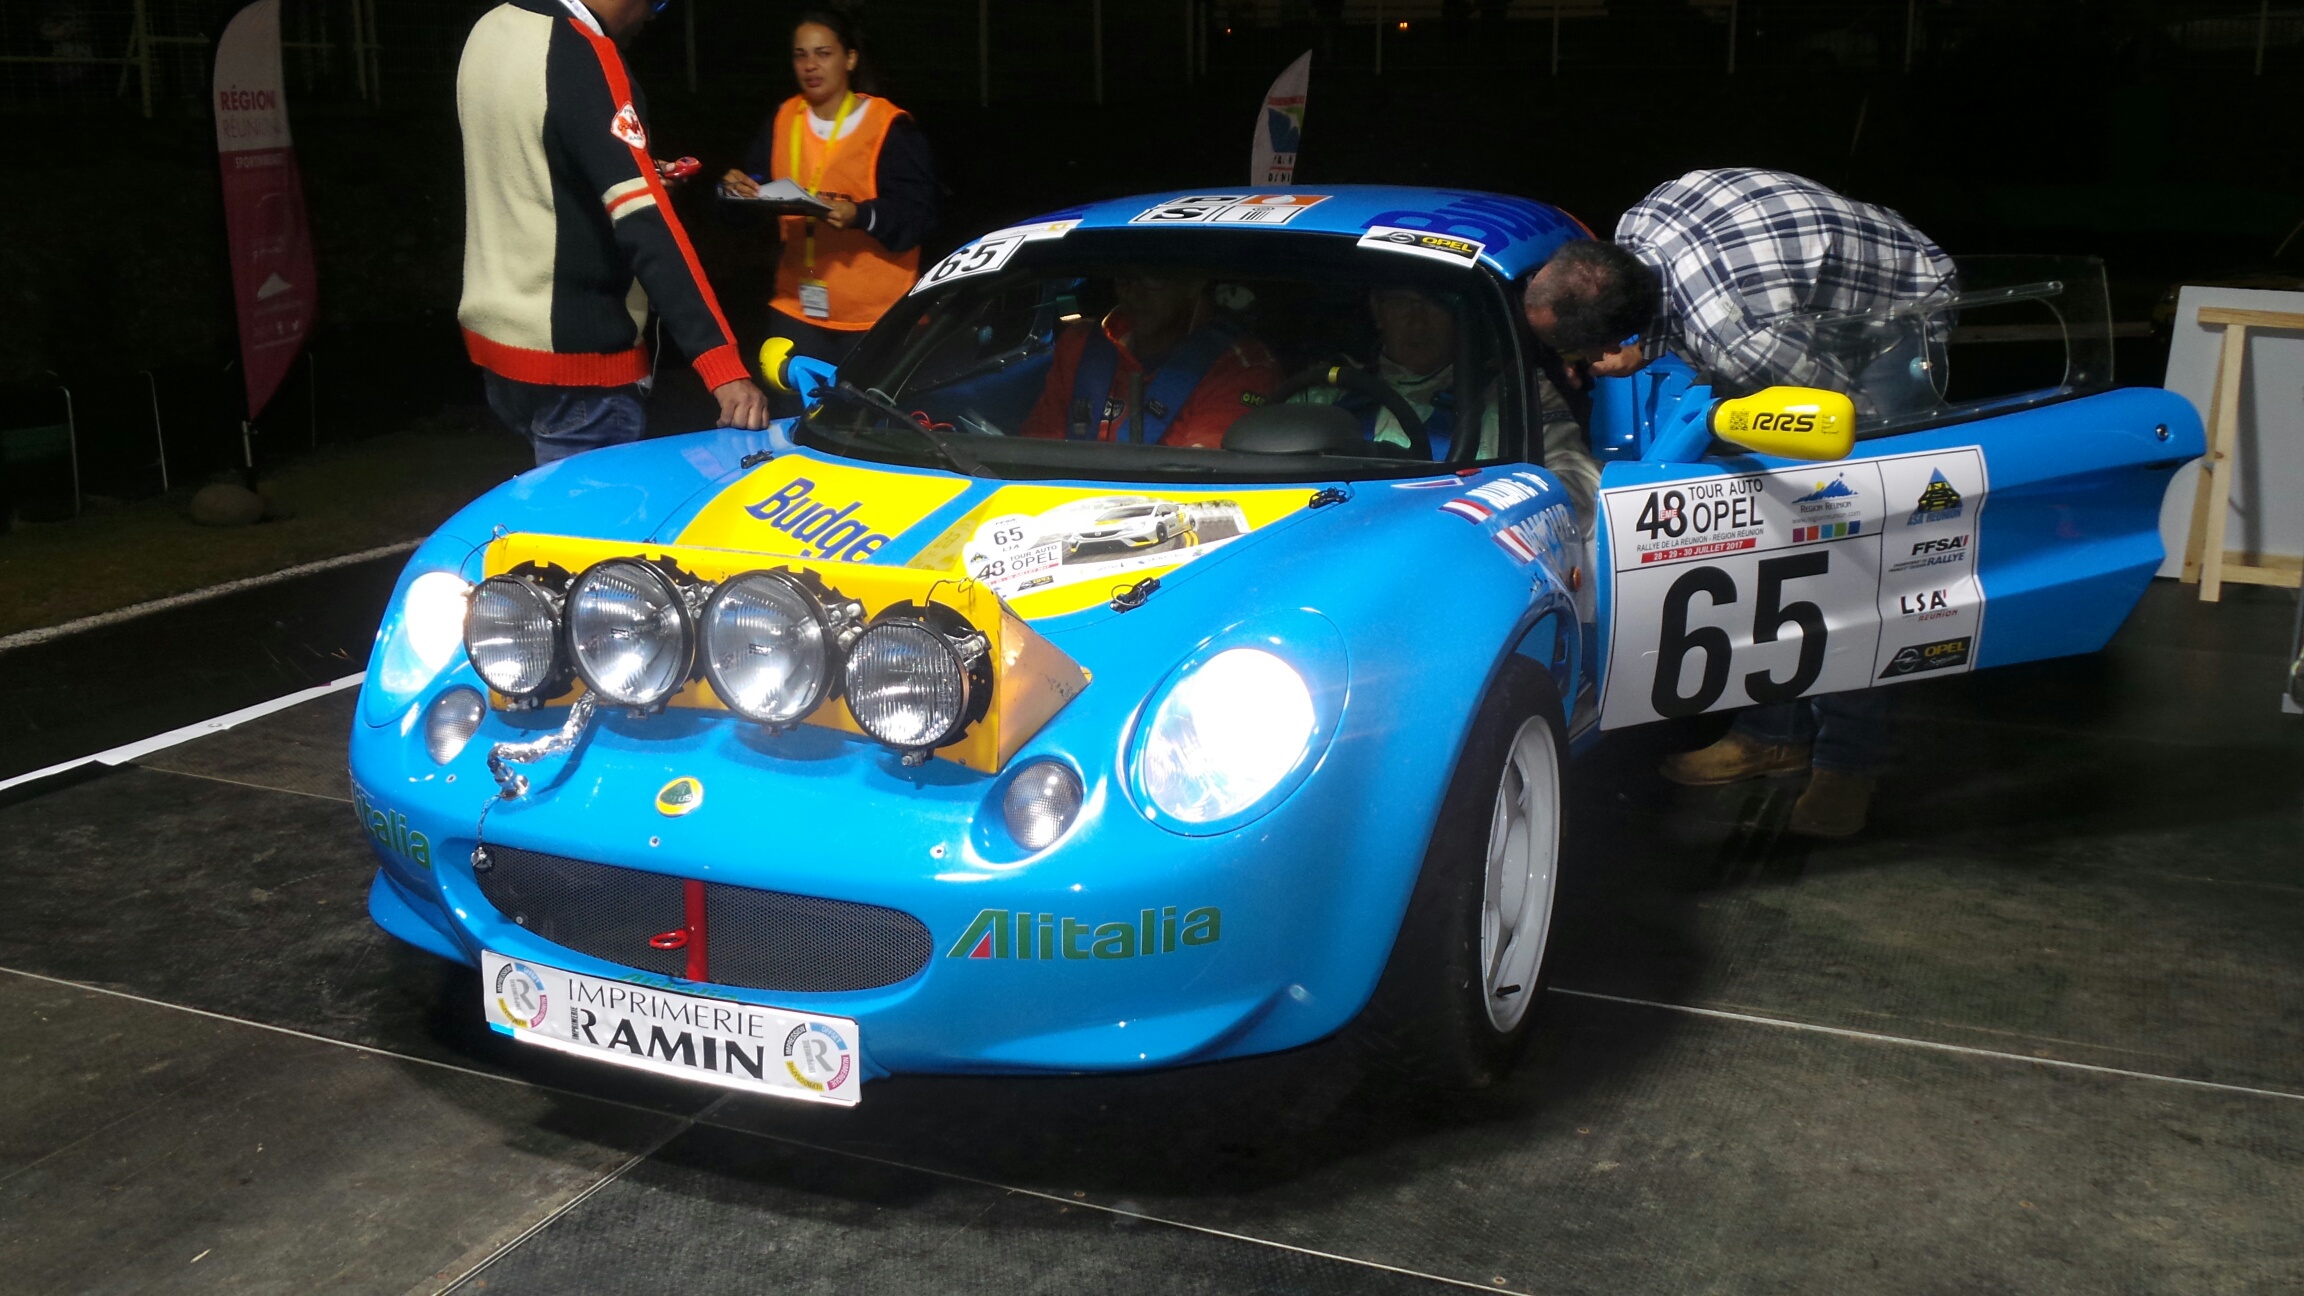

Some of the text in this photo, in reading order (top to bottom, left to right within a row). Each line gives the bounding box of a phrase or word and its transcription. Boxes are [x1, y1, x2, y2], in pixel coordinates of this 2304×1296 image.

[220, 84, 276, 111] RÉGION
[1422, 236, 1473, 253] OPEL
[930, 240, 1009, 282] 65
[1752, 412, 1817, 432] RRS
[1688, 478, 1764, 501] TOUR AUTO
[1636, 490, 1688, 540] 48
[1693, 496, 1765, 533] OPEL
[993, 526, 1024, 545] 65
[1636, 541, 1661, 552] RALLYE
[1661, 540, 1670, 549] DE
[1671, 538, 1680, 547] LA
[1911, 534, 1965, 556] FFSA
[1010, 545, 1057, 561] TOUR AUTO
[1011, 552, 1059, 570] OPEL
[1653, 552, 1663, 560] 28
[1669, 550, 1678, 559] 29
[1683, 548, 1692, 556] 30
[1694, 542, 1725, 555] JUILLET
[1726, 540, 1744, 551] 2017
[1927, 552, 1965, 566] RALLYE
[977, 560, 1006, 580] 48
[1901, 589, 1947, 614] LSA
[1651, 550, 1829, 718] 65
[1924, 641, 1966, 657] OPEL
[946, 906, 1222, 960] Alitalia
[569, 978, 765, 1038] IMPRIMERIE
[580, 1008, 765, 1080] RAMIN
[785, 1025, 806, 1055] IMPRESSION
[821, 1026, 841, 1043] OFFSET
[811, 1039, 834, 1072] R
